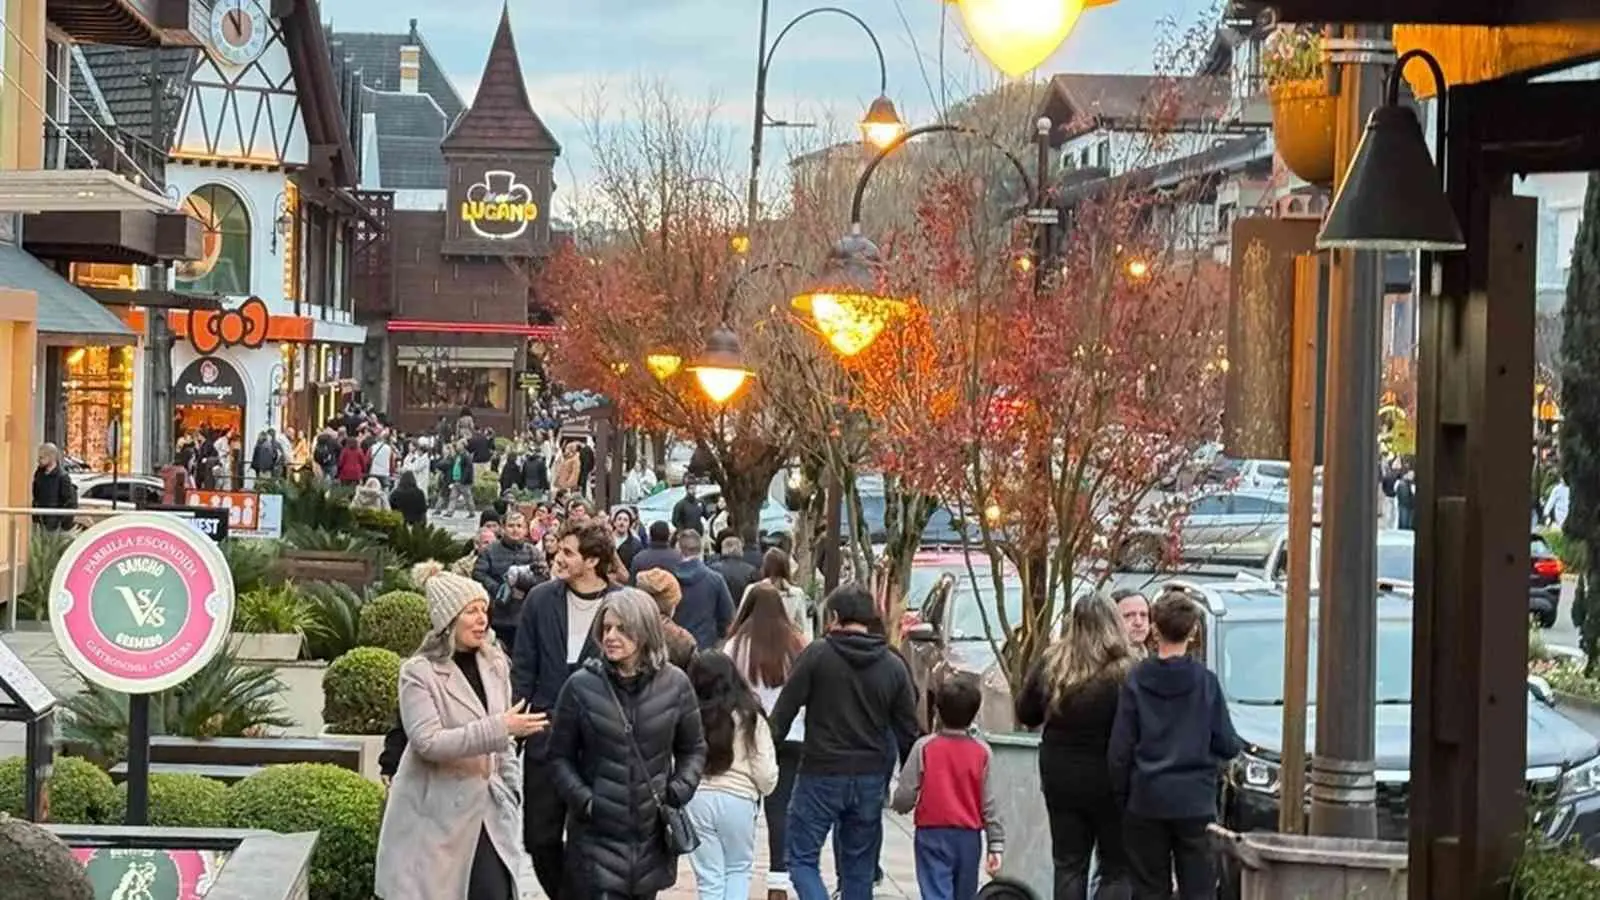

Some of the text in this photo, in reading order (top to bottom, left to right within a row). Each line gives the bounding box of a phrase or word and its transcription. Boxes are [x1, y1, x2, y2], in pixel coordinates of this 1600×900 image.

[462, 201, 538, 222] LUGANO
[84, 535, 199, 577] PARRILLA ESCONDIDA
[116, 556, 166, 577] RANCHO
